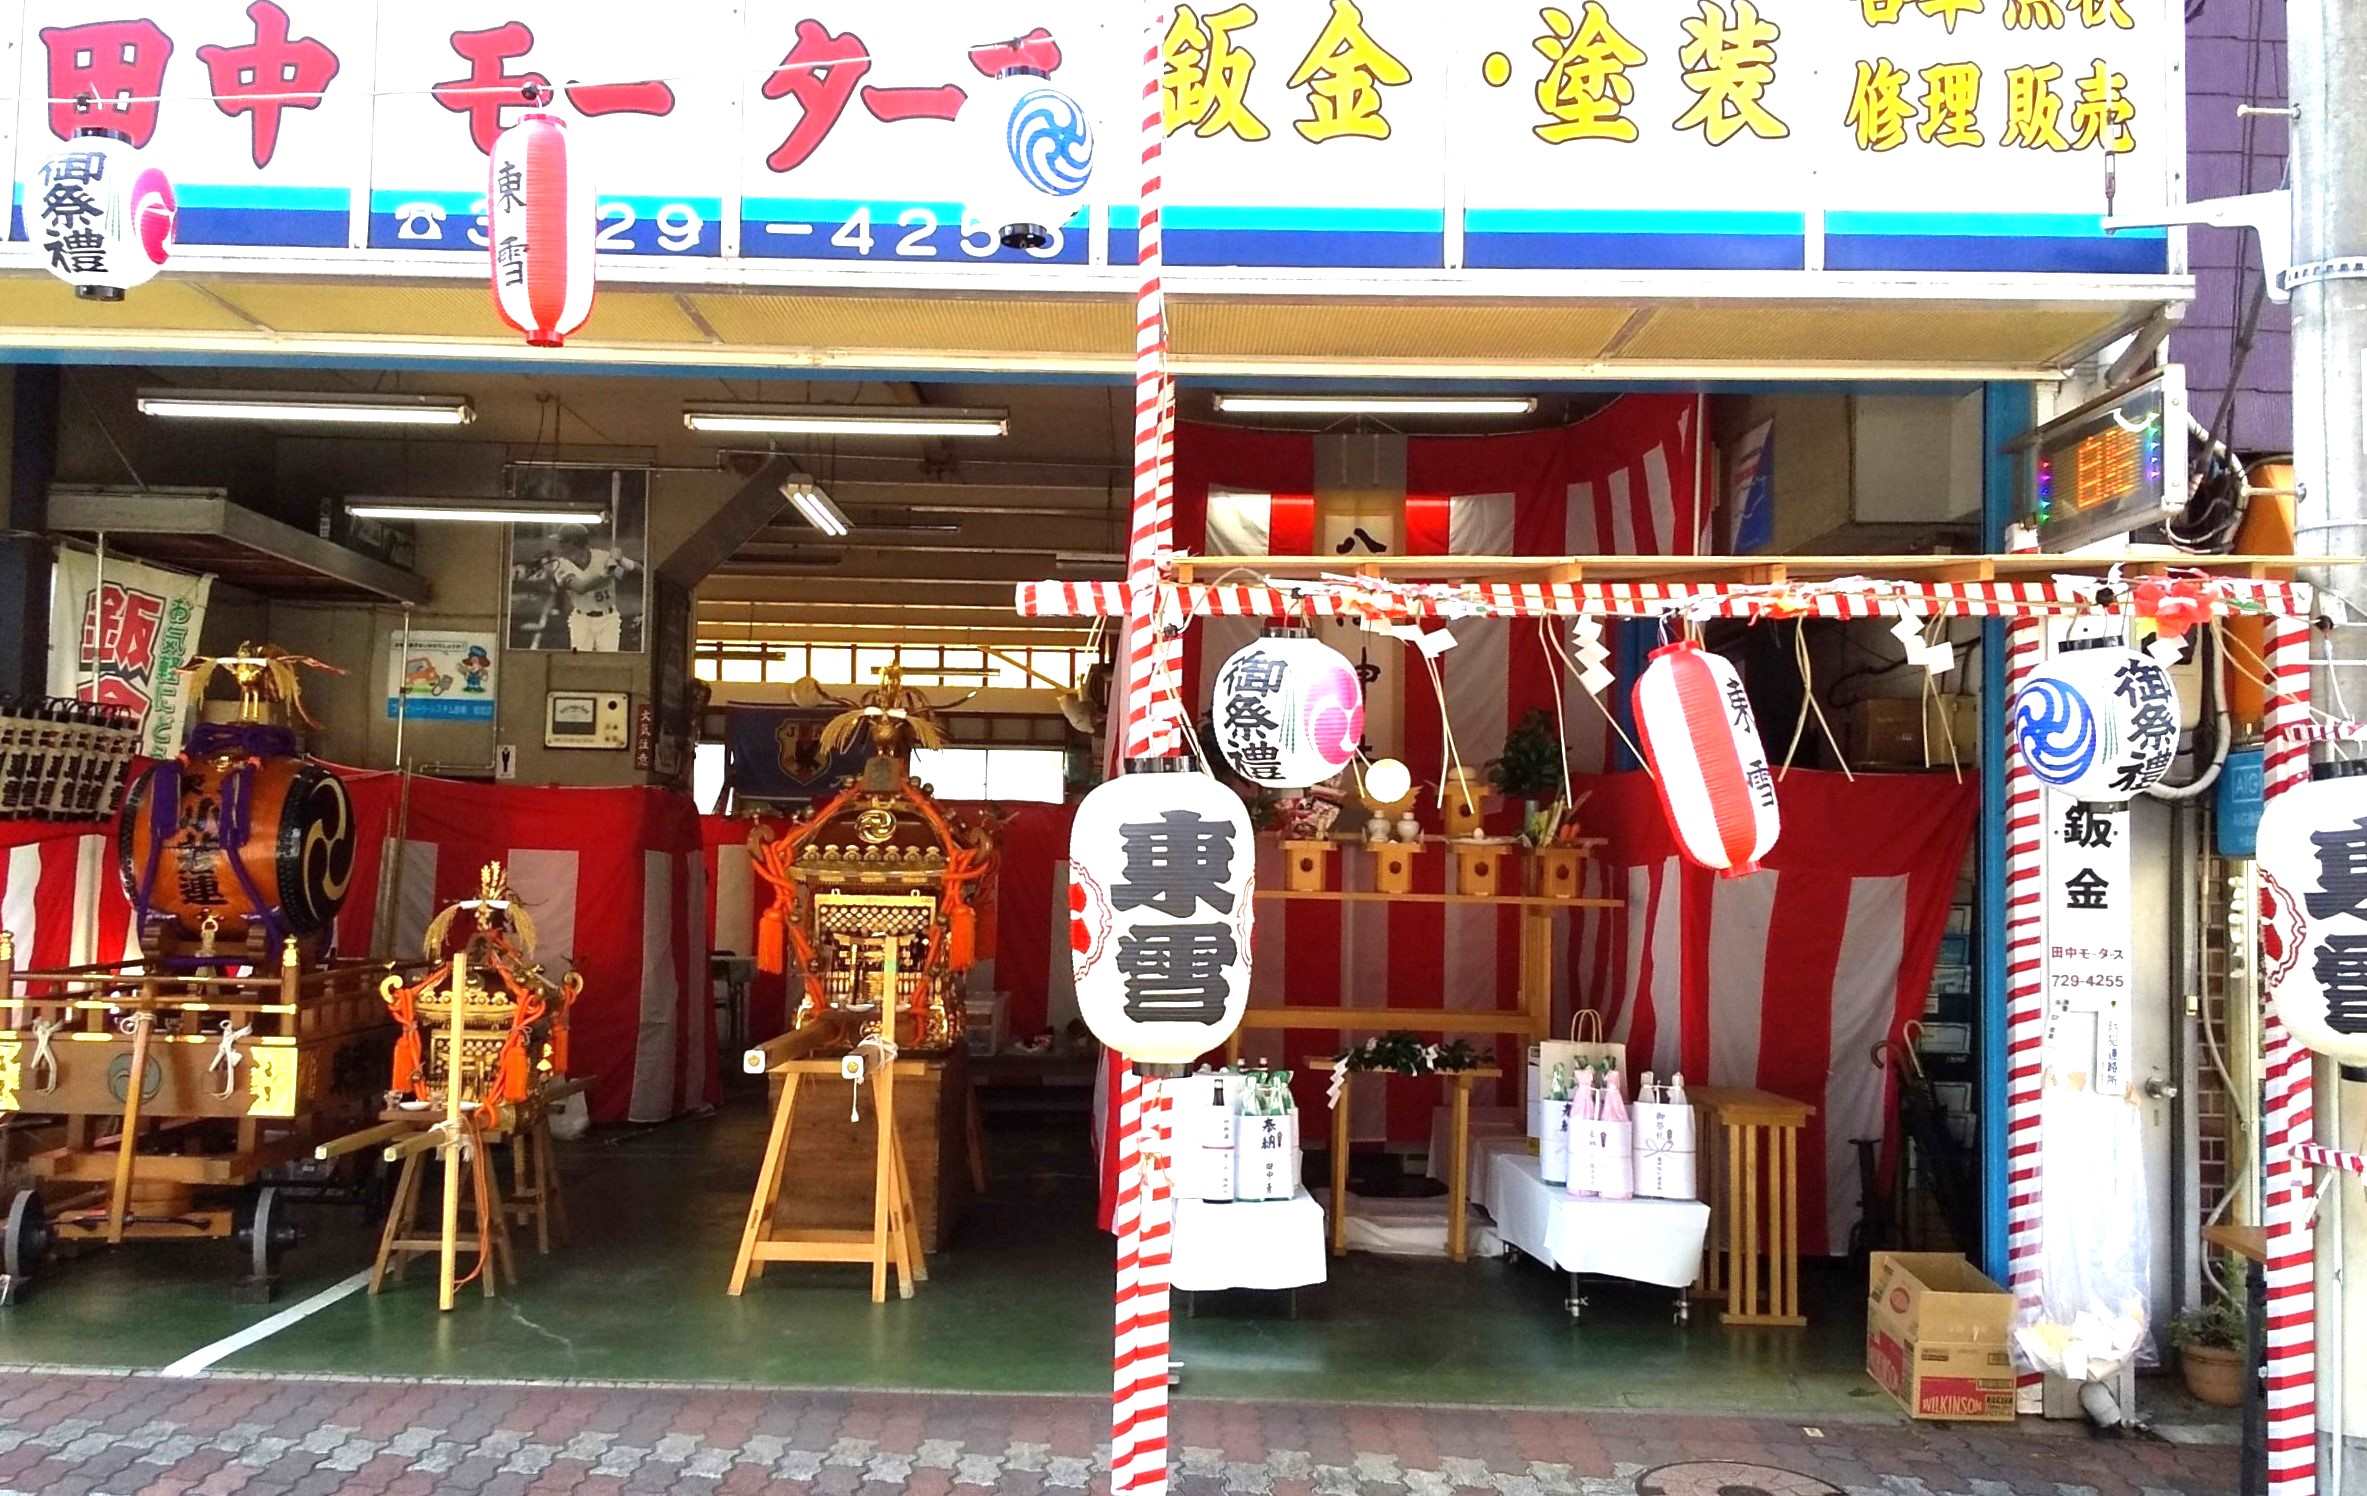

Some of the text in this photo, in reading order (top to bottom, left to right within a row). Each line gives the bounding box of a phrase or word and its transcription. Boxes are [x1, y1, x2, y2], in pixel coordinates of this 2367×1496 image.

[1845, 56, 2136, 153] 修理販売
[38, 150, 110, 274] 御祭禮
[1222, 650, 1290, 781] 御祭禮
[2108, 658, 2177, 793] 御祭禮
[2234, 772, 2259, 795] AIG
[2051, 974, 2125, 988] 729-4255
[1922, 1394, 1985, 1415] WILKINSON
